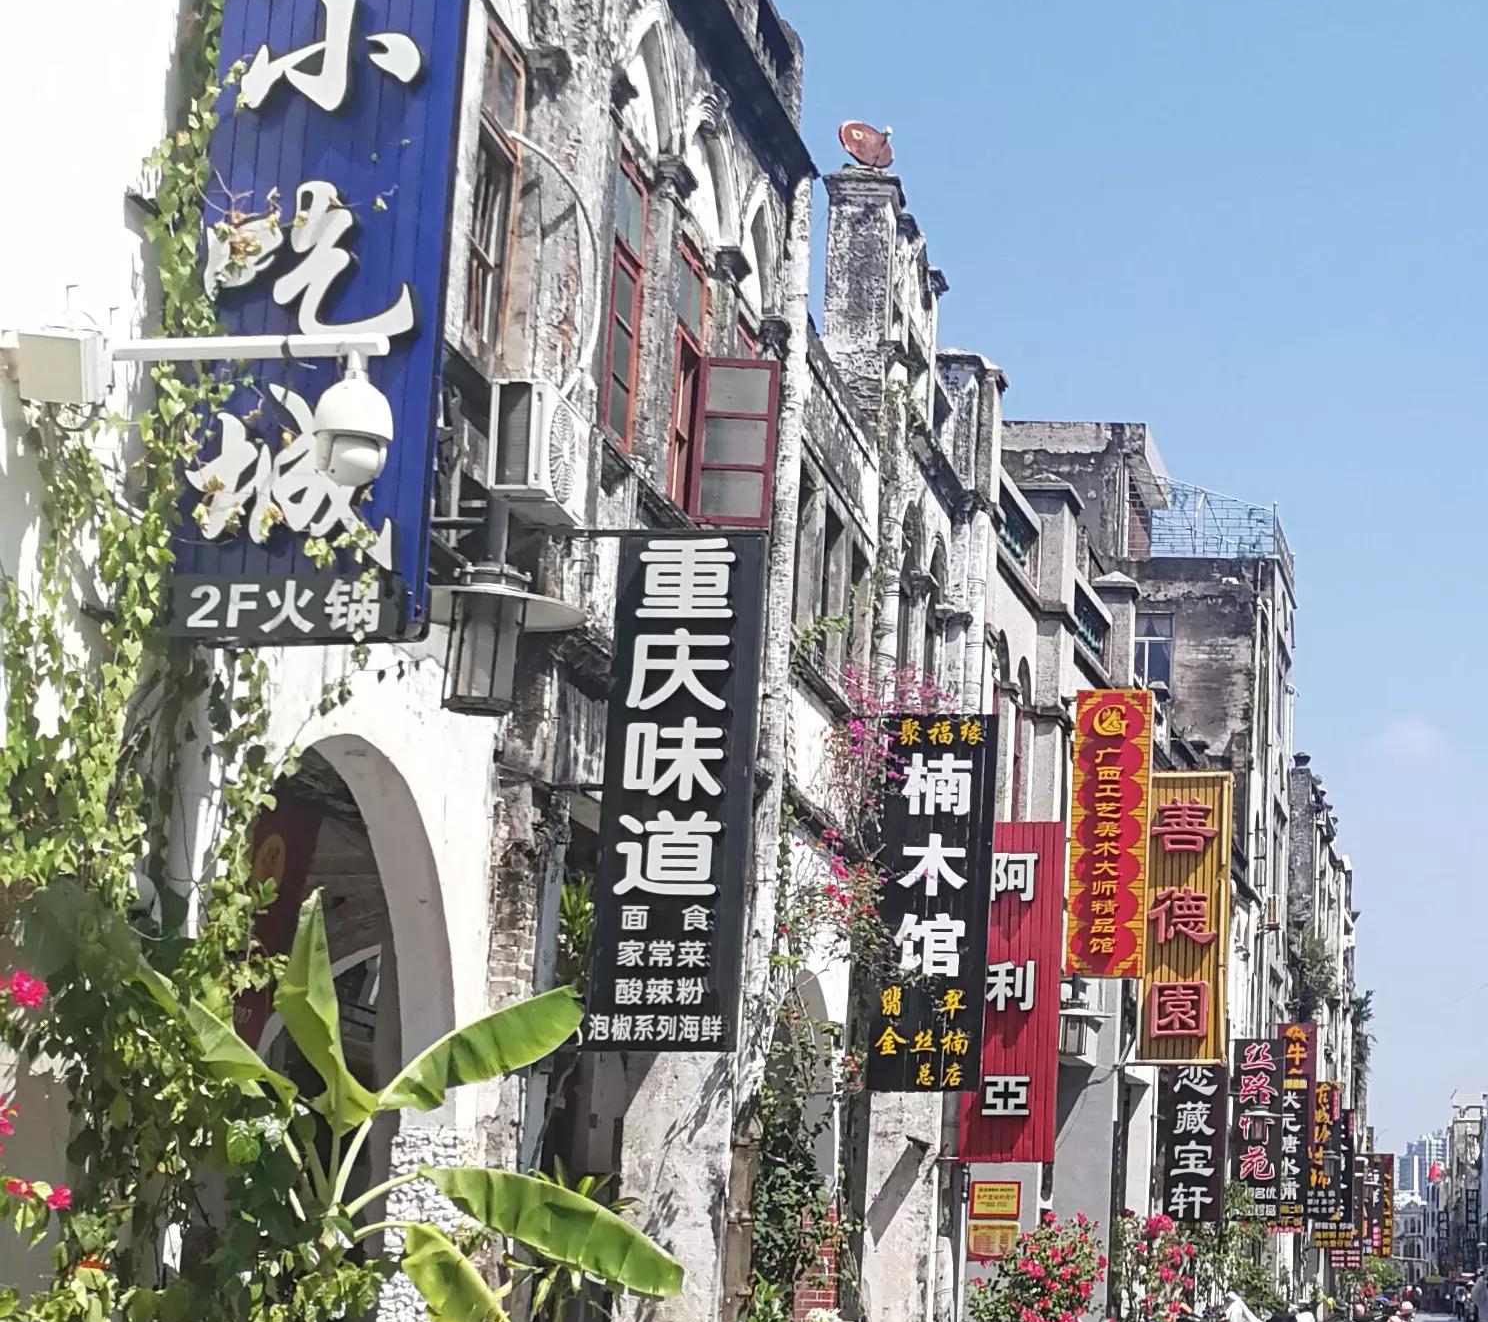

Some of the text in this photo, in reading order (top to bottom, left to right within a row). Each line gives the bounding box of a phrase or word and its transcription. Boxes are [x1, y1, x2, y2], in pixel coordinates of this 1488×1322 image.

[186, 579, 382, 634] 2F火锅
[613, 537, 737, 896] 重庆味道
[899, 718, 985, 746] 聚福缘
[893, 753, 973, 977] 楠木馆
[1088, 747, 1123, 955] 广西工艺美术大师精品馆
[621, 904, 711, 932] 面食
[1148, 797, 1220, 1039] 善德園
[617, 940, 707, 968] 家常菜
[614, 978, 702, 1006] 酸辣粉
[588, 1013, 723, 1044] 泡椒系列海鲜
[874, 1029, 969, 1057] 金丝楠
